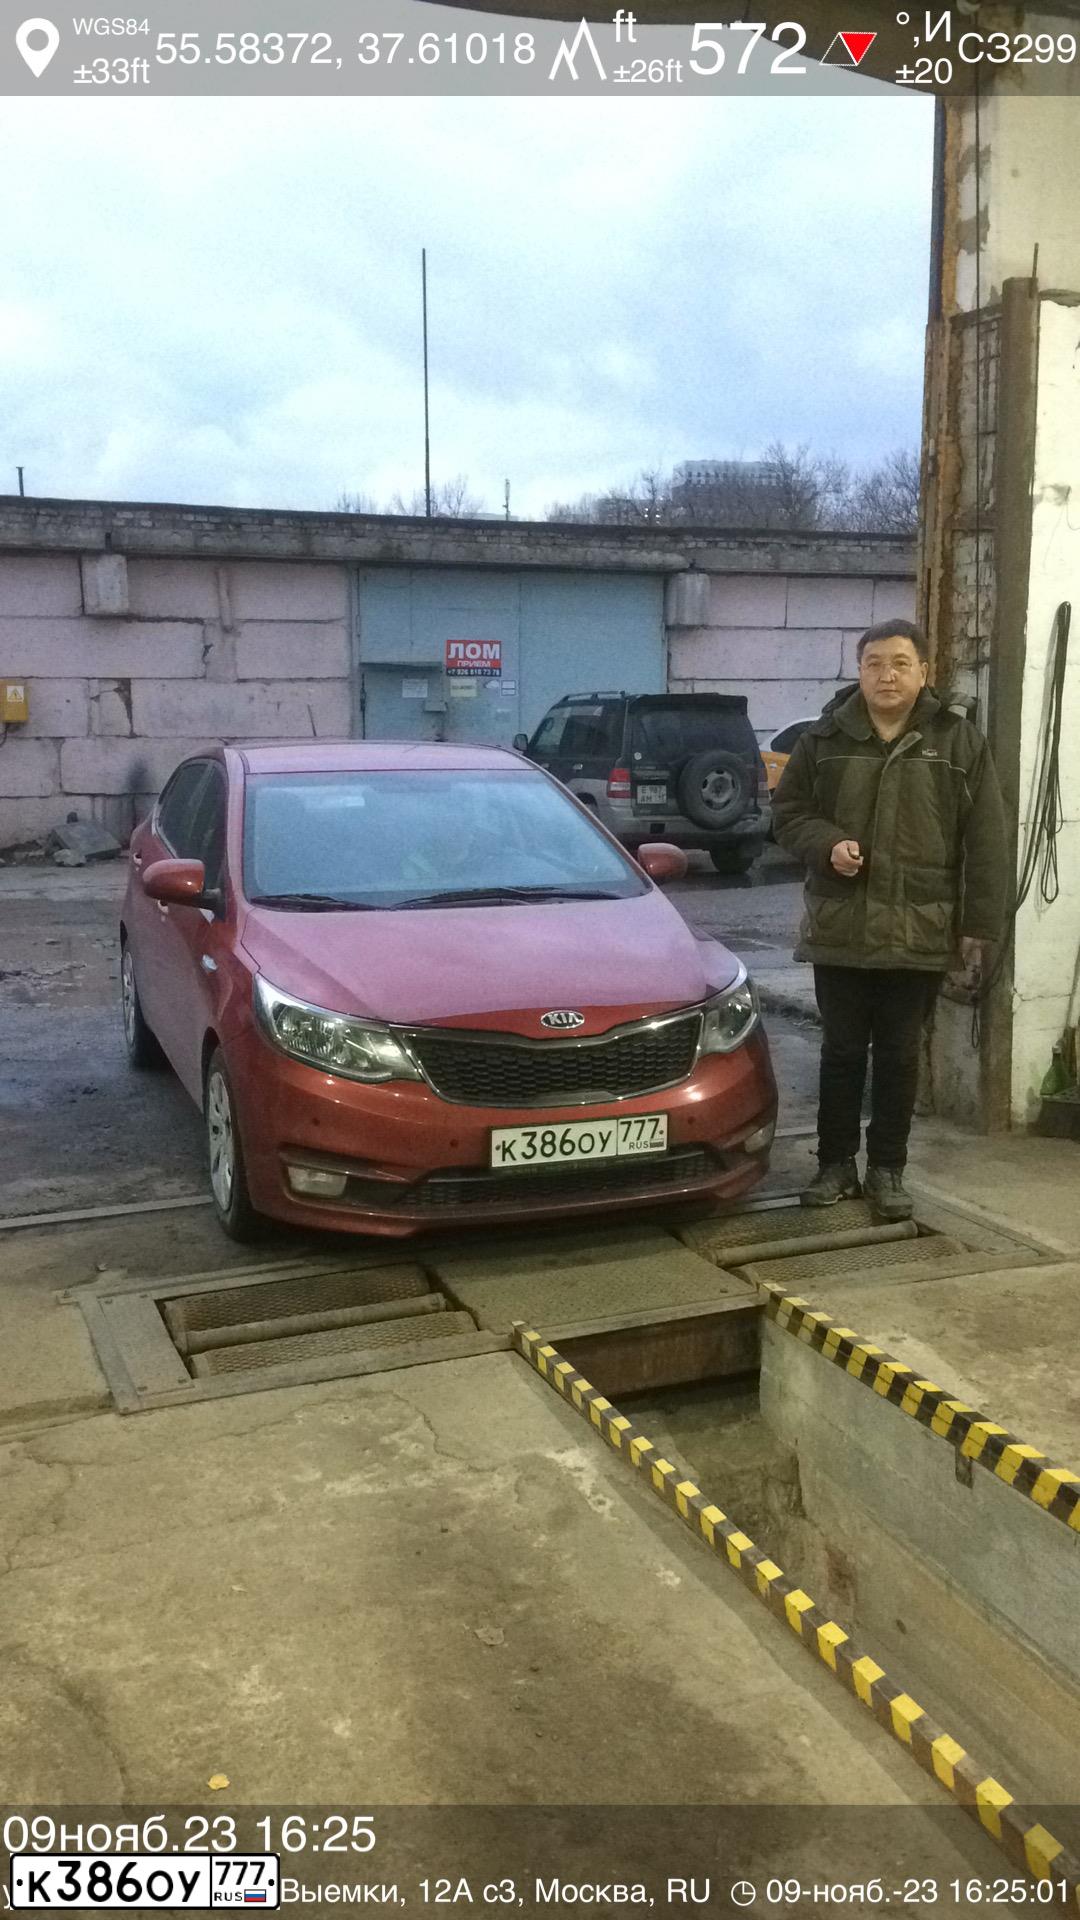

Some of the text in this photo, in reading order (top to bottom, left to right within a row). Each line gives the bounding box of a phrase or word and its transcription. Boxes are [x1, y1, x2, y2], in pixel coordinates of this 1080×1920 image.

[447, 642, 500, 659] ЛОМ
[548, 1012, 581, 1025] KIA
[619, 1117, 660, 1143] 777
[629, 1140, 649, 1150] RUS
